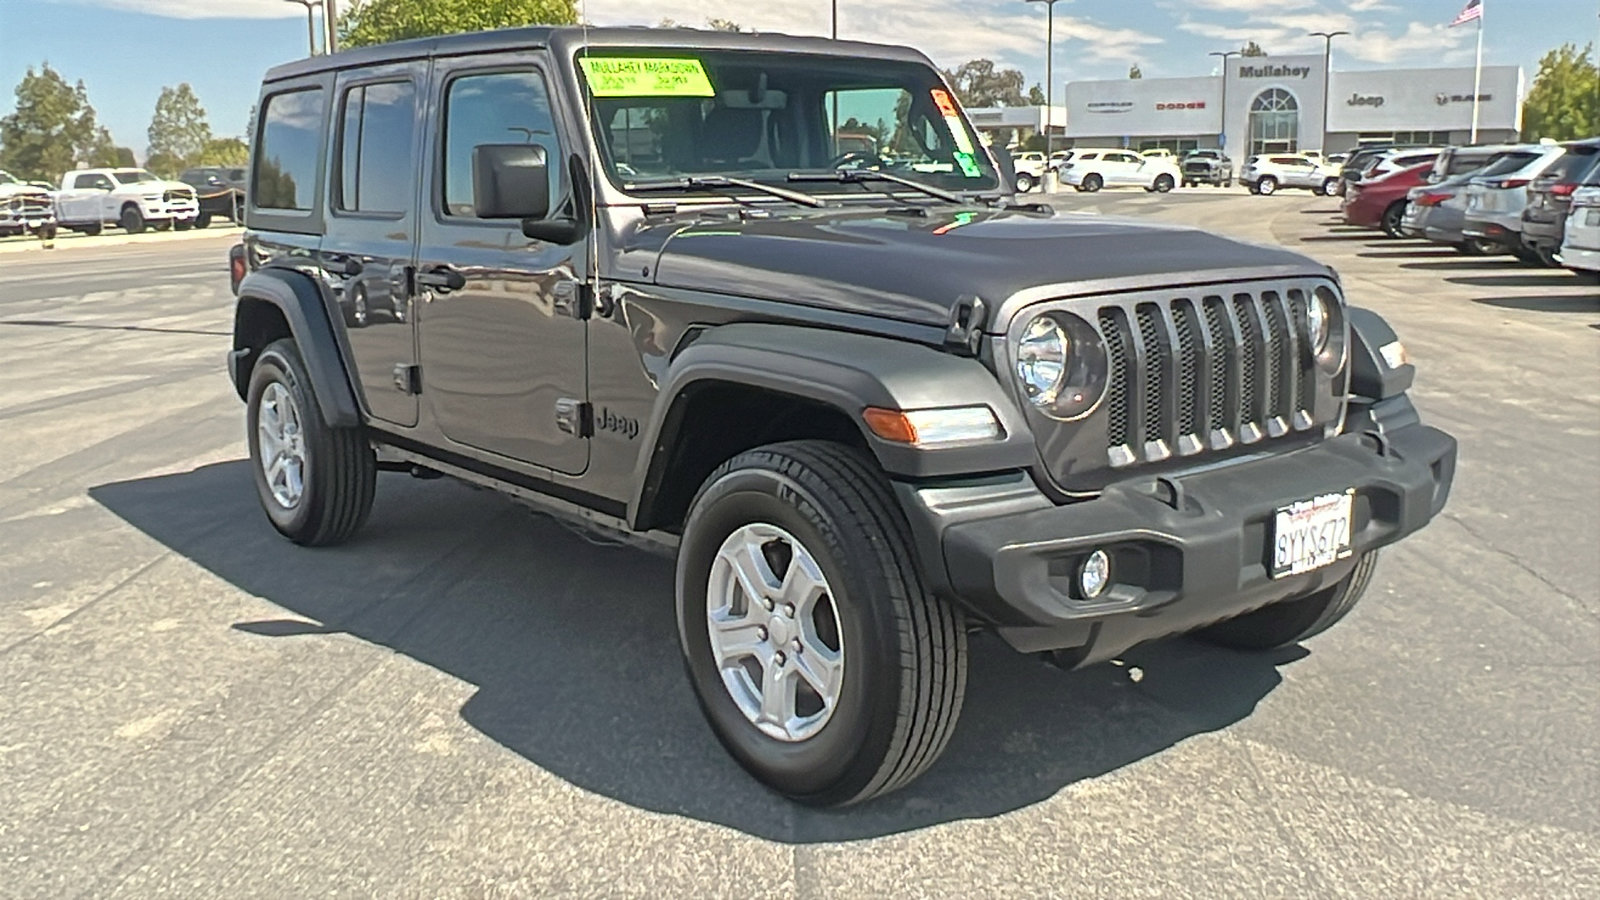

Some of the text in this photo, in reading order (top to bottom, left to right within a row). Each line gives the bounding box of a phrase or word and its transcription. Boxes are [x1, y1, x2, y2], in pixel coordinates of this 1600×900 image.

[1240, 65, 1310, 79] Mullahey
[1156, 101, 1205, 110] DODGE
[1347, 93, 1384, 108] Jeep
[597, 407, 639, 440] Jeep
